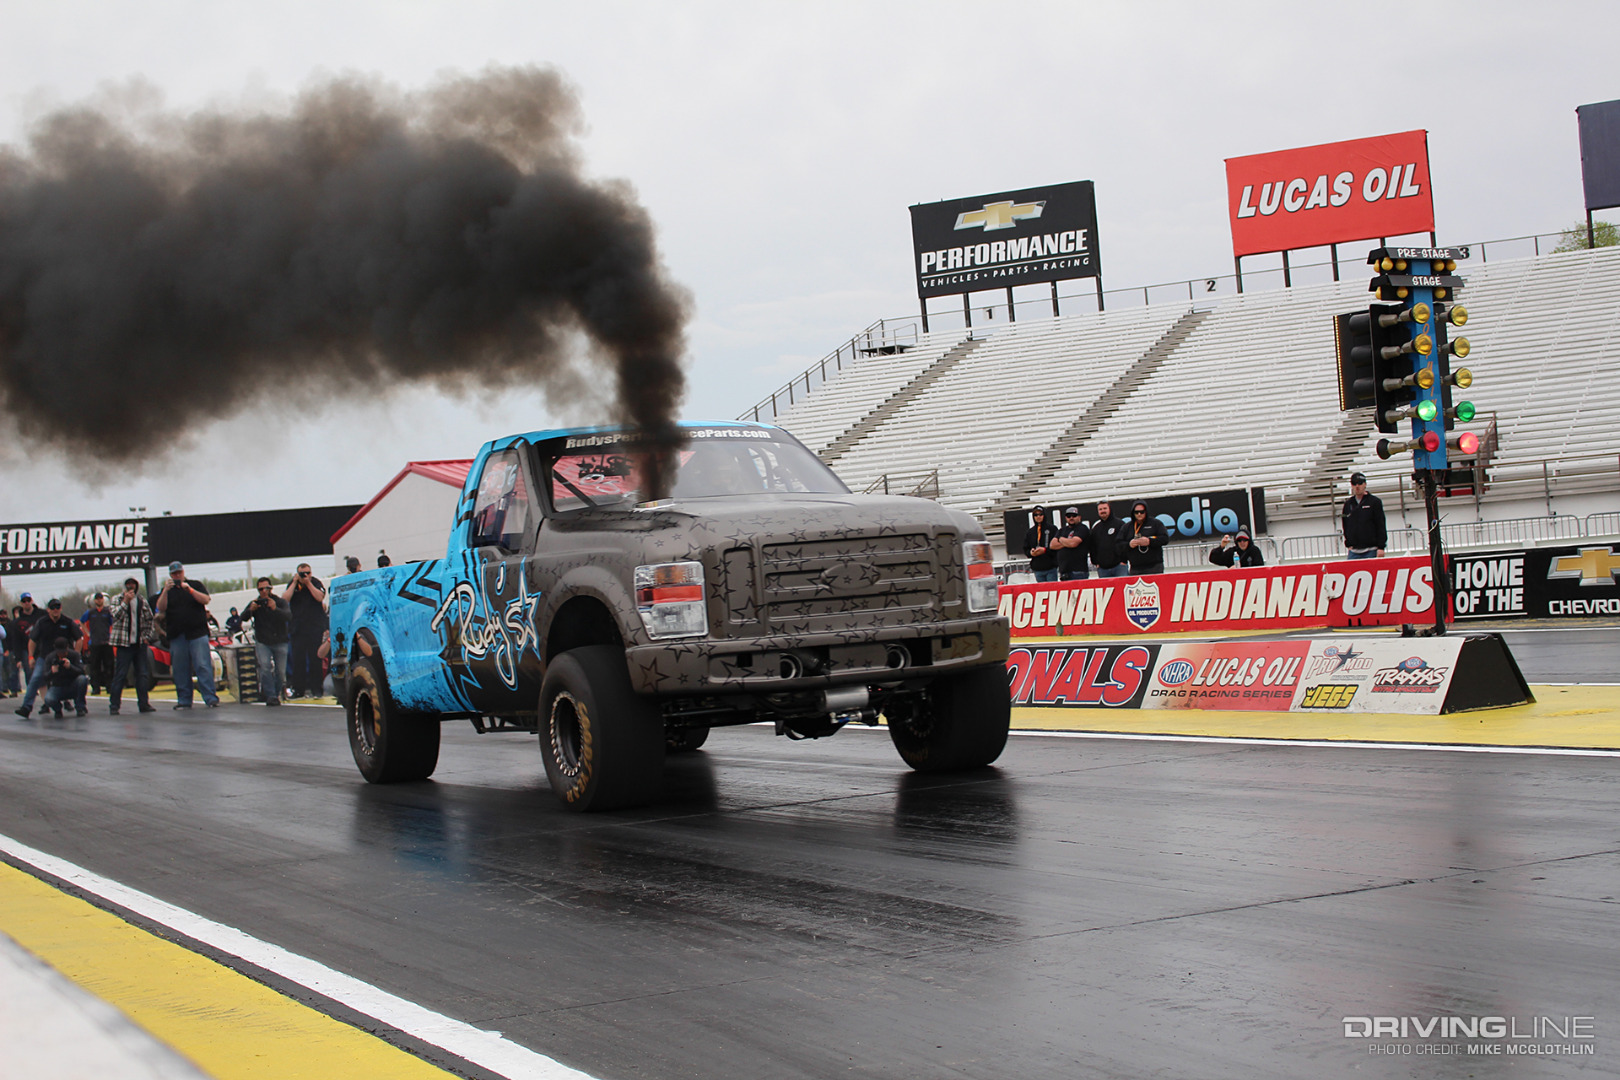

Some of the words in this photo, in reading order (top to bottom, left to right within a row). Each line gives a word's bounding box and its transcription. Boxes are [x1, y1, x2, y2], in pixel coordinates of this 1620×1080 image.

[1237, 171, 1354, 219] LUCAS
[1362, 163, 1422, 203] OIL
[920, 229, 1088, 274] PERFORMANCE
[1397, 248, 1451, 259] PRE-STAGE
[922, 273, 979, 288] VEHICLES
[993, 265, 1029, 278] PARTS
[1043, 257, 1090, 271] RACING
[1412, 276, 1442, 286] STAGE
[1206, 280, 1216, 292] 2
[985, 308, 993, 320] 1
[30, 558, 76, 570] PARTS
[93, 555, 150, 567] RACING
[1455, 558, 1524, 590] HOME
[1130, 595, 1156, 607] LUCAS
[1170, 565, 1435, 623] INDIANAPOLIS
[1455, 590, 1481, 614] OF
[1486, 587, 1524, 612] THE
[1549, 598, 1620, 614] CHEVRO
[1160, 660, 1195, 685] NHRA
[1192, 657, 1265, 687] LUCAS
[1263, 656, 1303, 687] OIL
[1373, 667, 1449, 686] TRAXXAS
[1150, 689, 1187, 698] DRAG
[1189, 689, 1240, 698] RACING
[1242, 690, 1292, 699] SERIES
[1301, 684, 1359, 709] JEGS
